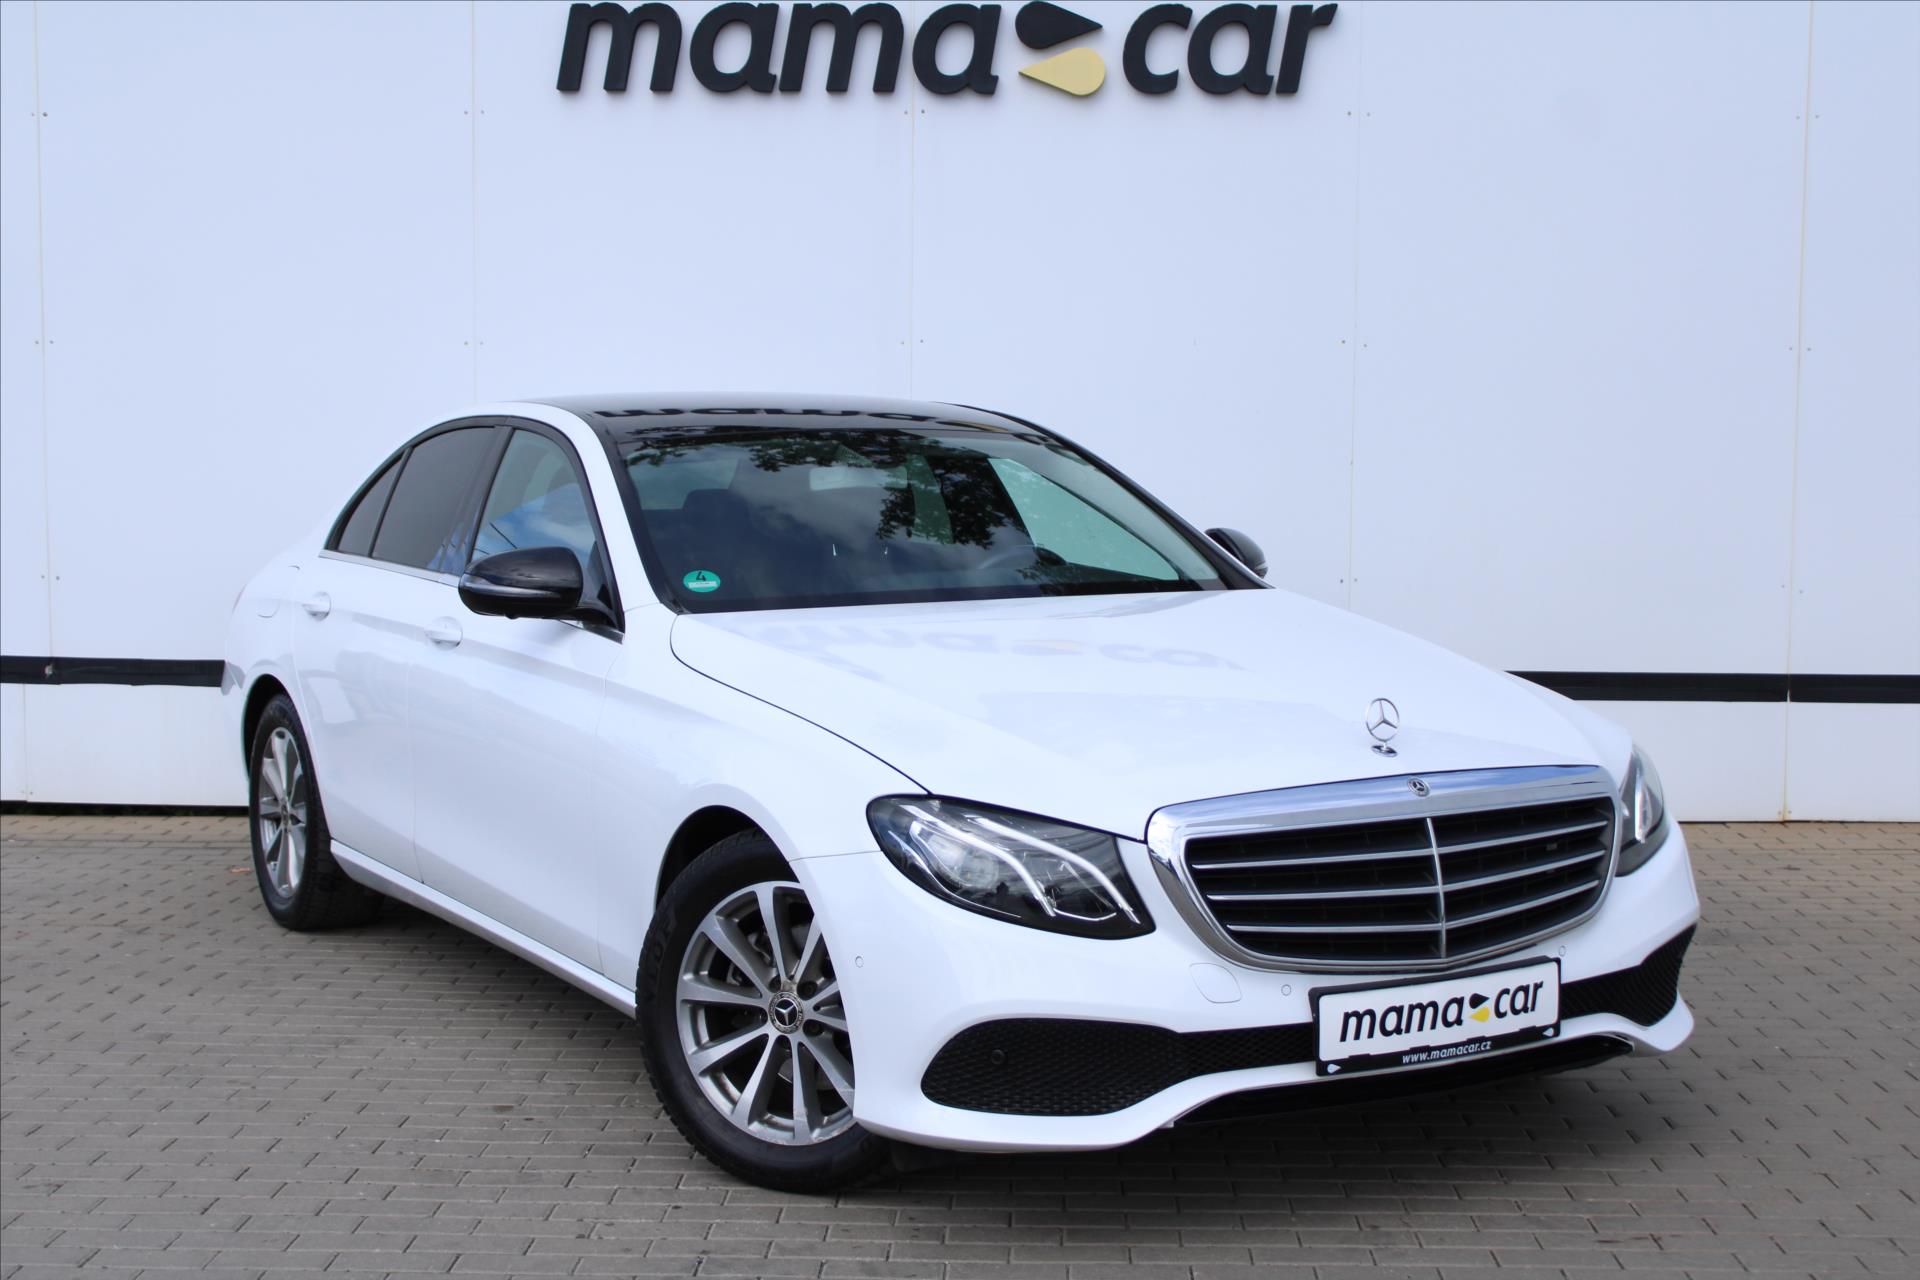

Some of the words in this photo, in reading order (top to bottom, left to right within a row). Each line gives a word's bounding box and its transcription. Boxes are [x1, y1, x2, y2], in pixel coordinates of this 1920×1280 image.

[556, 2, 1000, 95] mama
[1122, 3, 1338, 95] car
[696, 571, 706, 581] 4
[1339, 996, 1465, 1042] mama
[1494, 980, 1544, 1019] car
[1402, 1041, 1492, 1064] www.mamacar.cz
